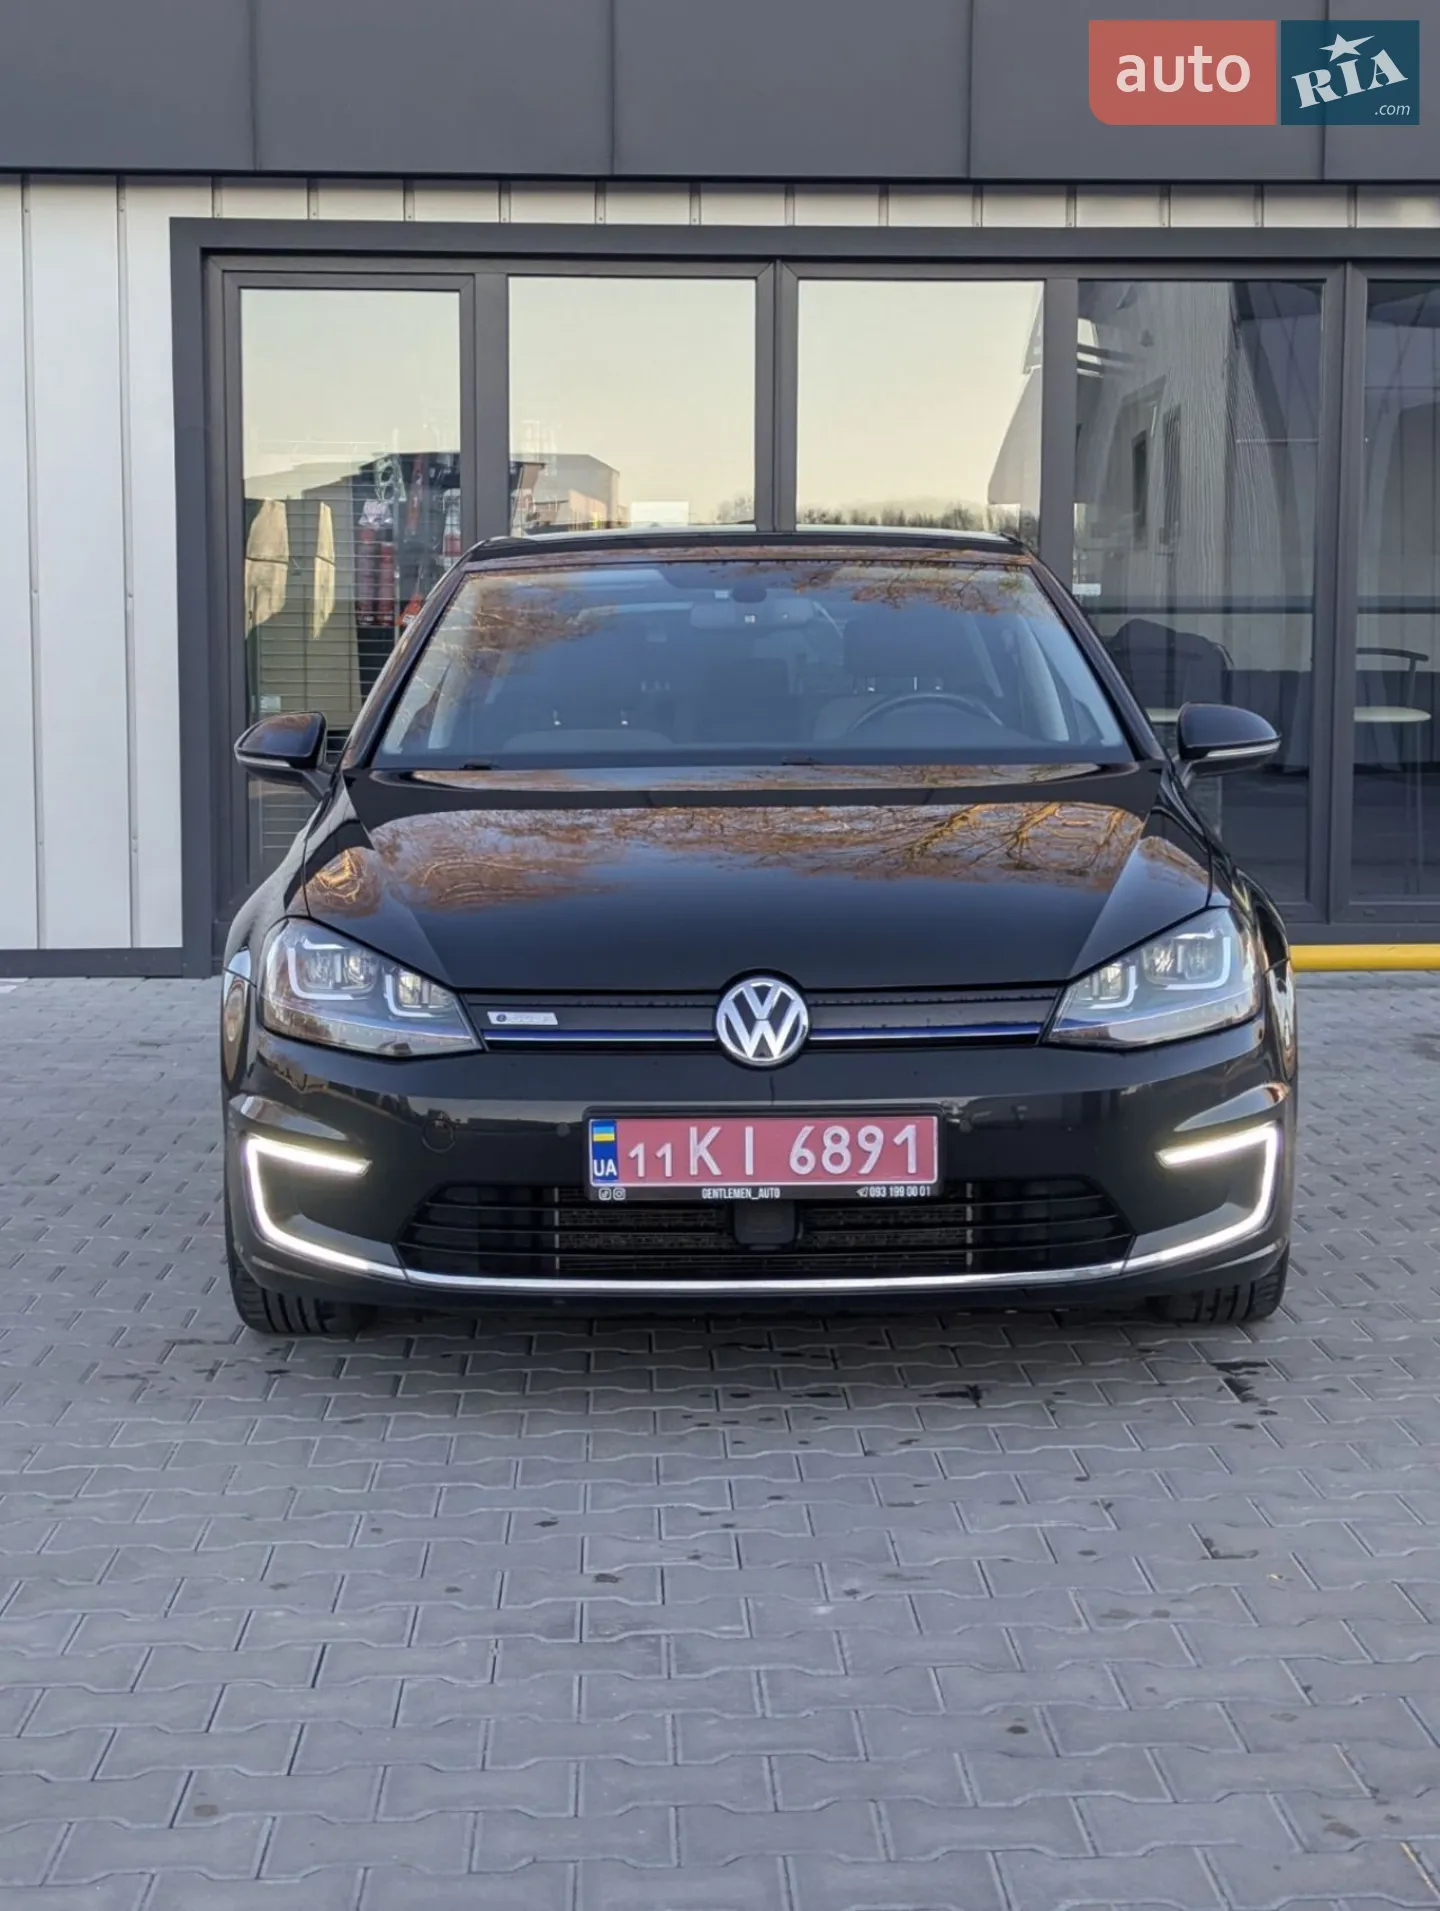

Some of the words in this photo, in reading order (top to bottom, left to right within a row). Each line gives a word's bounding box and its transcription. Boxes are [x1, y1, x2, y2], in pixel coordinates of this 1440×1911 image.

[789, 1124, 918, 1175] 6891
[593, 1159, 617, 1177] UA
[701, 1187, 781, 1200] GENTLEMEN_AUTO
